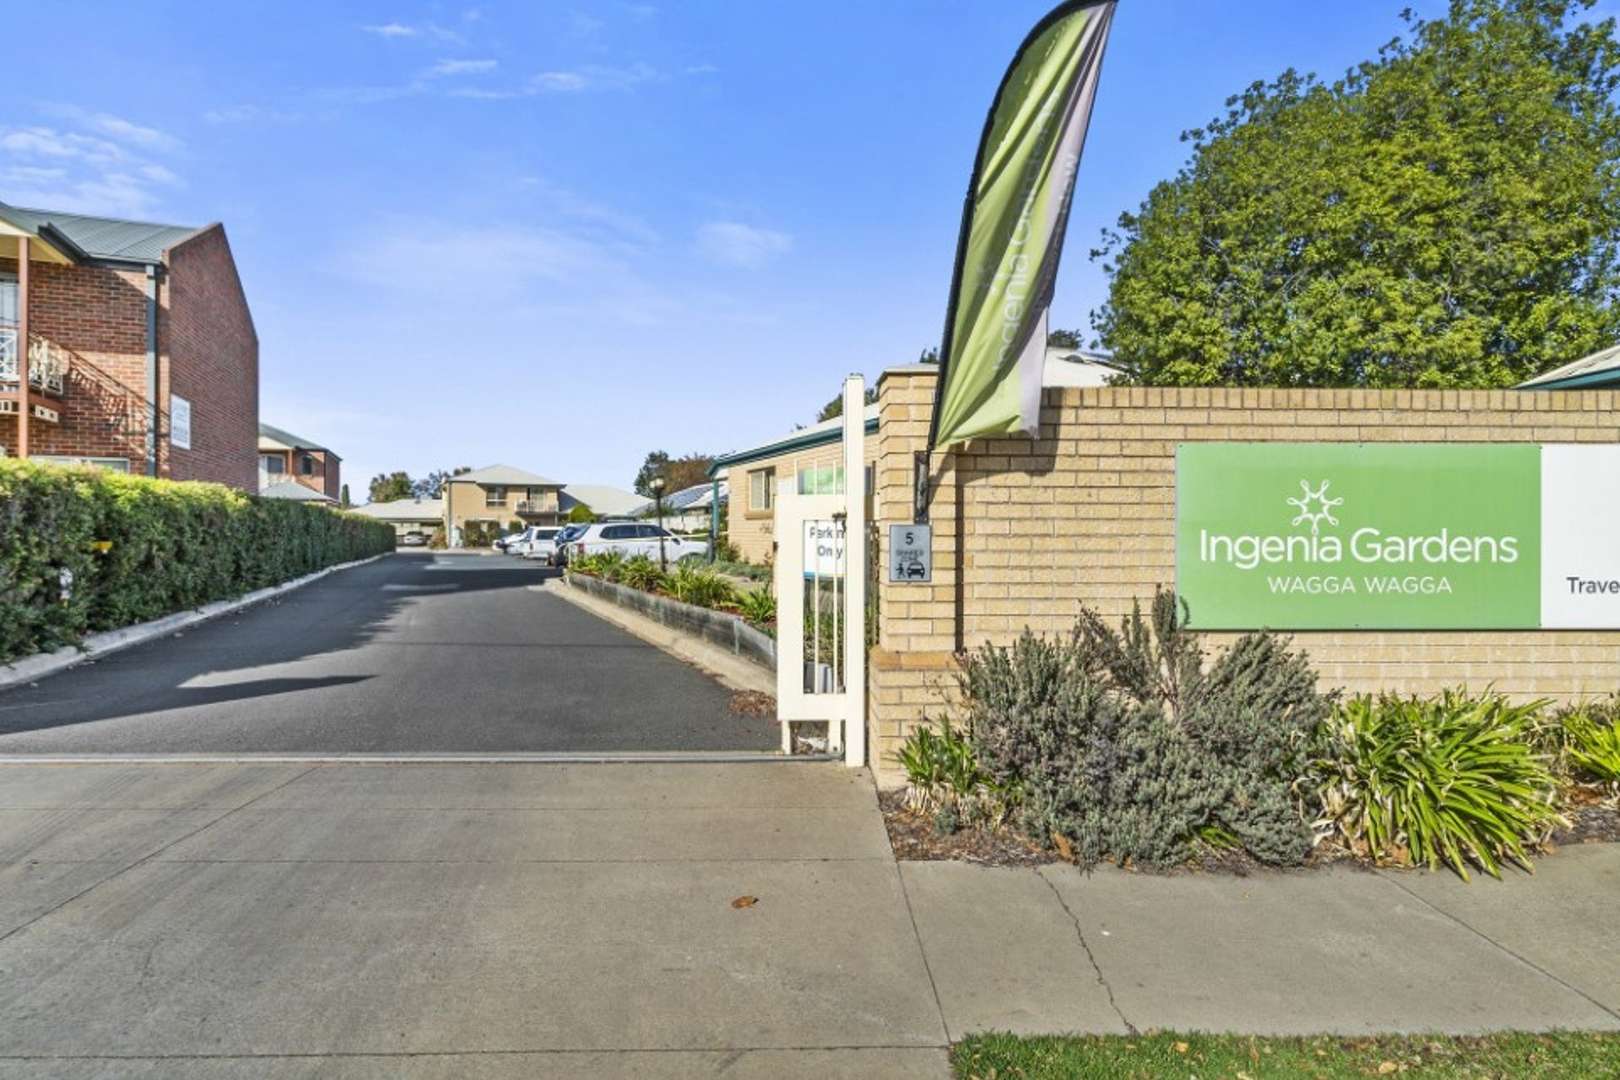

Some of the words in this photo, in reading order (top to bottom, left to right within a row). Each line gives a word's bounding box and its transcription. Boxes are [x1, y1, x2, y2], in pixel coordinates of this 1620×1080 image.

[992, 253, 1031, 370] genia
[905, 532, 914, 545] 5
[816, 544, 843, 560] Ony
[1200, 528, 1342, 570] Ingenia
[1350, 527, 1518, 563] Gardens
[1268, 576, 1355, 594] WAGGA
[1364, 576, 1452, 594] WAGGA
[1565, 576, 1620, 594] Trave
